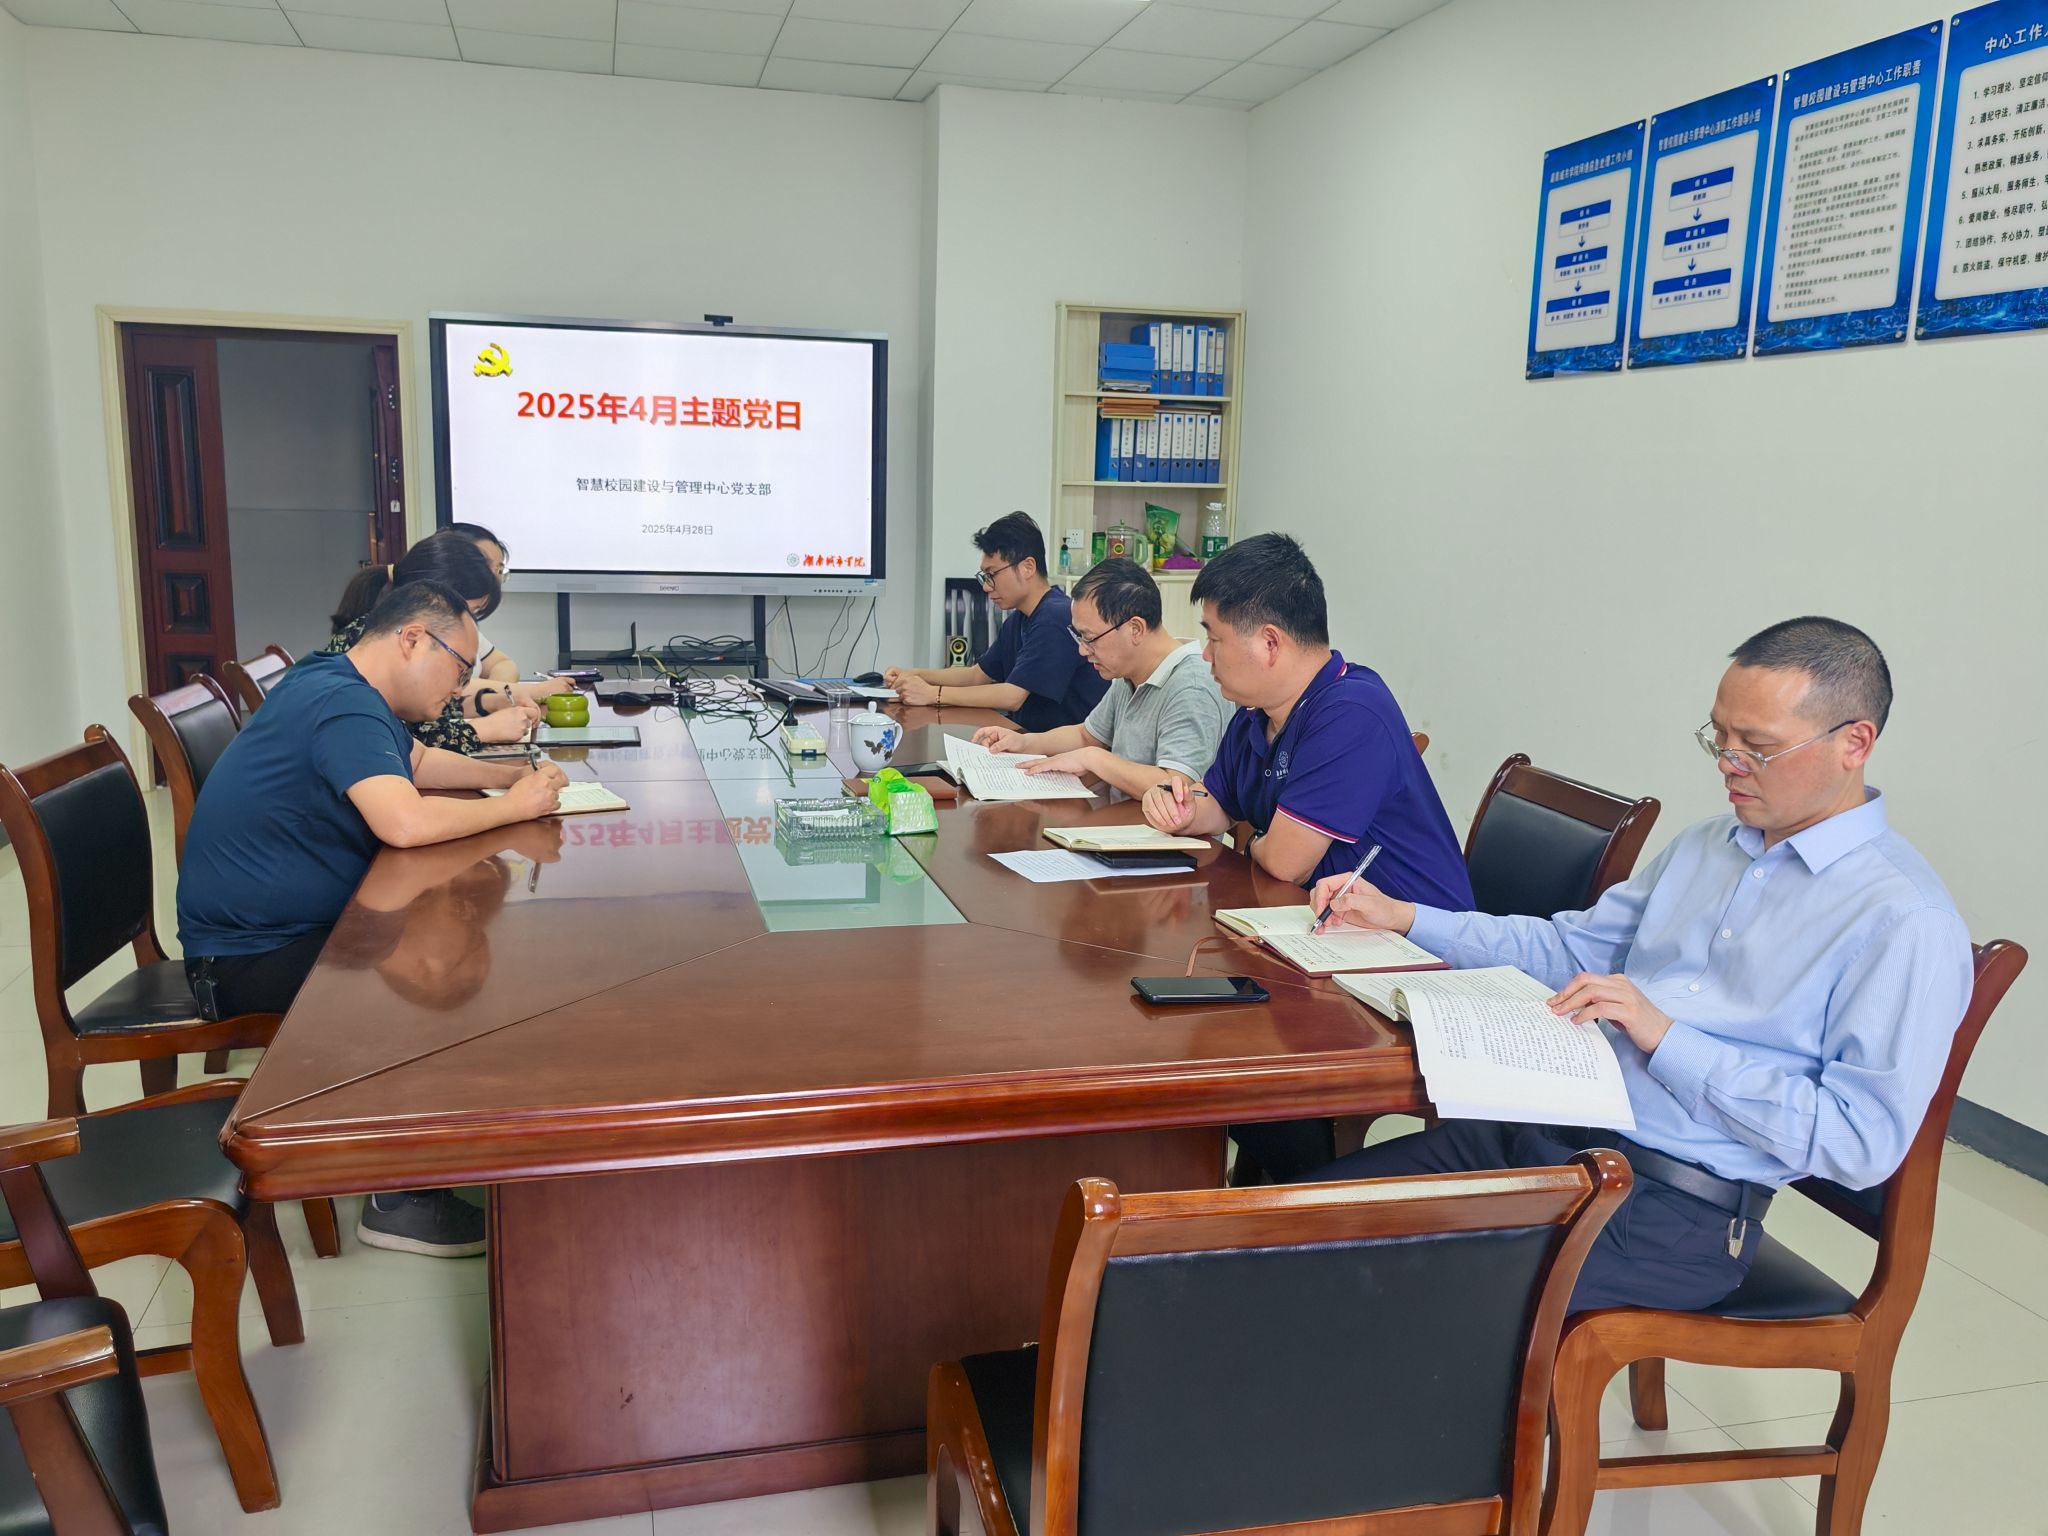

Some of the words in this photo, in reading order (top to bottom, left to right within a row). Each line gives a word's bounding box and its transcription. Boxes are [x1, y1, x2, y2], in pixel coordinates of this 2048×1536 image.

[1984, 23, 2048, 53] 中心工作
[517, 391, 802, 431] 2025年4月主题党日
[576, 477, 772, 496] 智慧校园建设与管理中心党支部
[641, 524, 713, 536] 2025年4月28日
